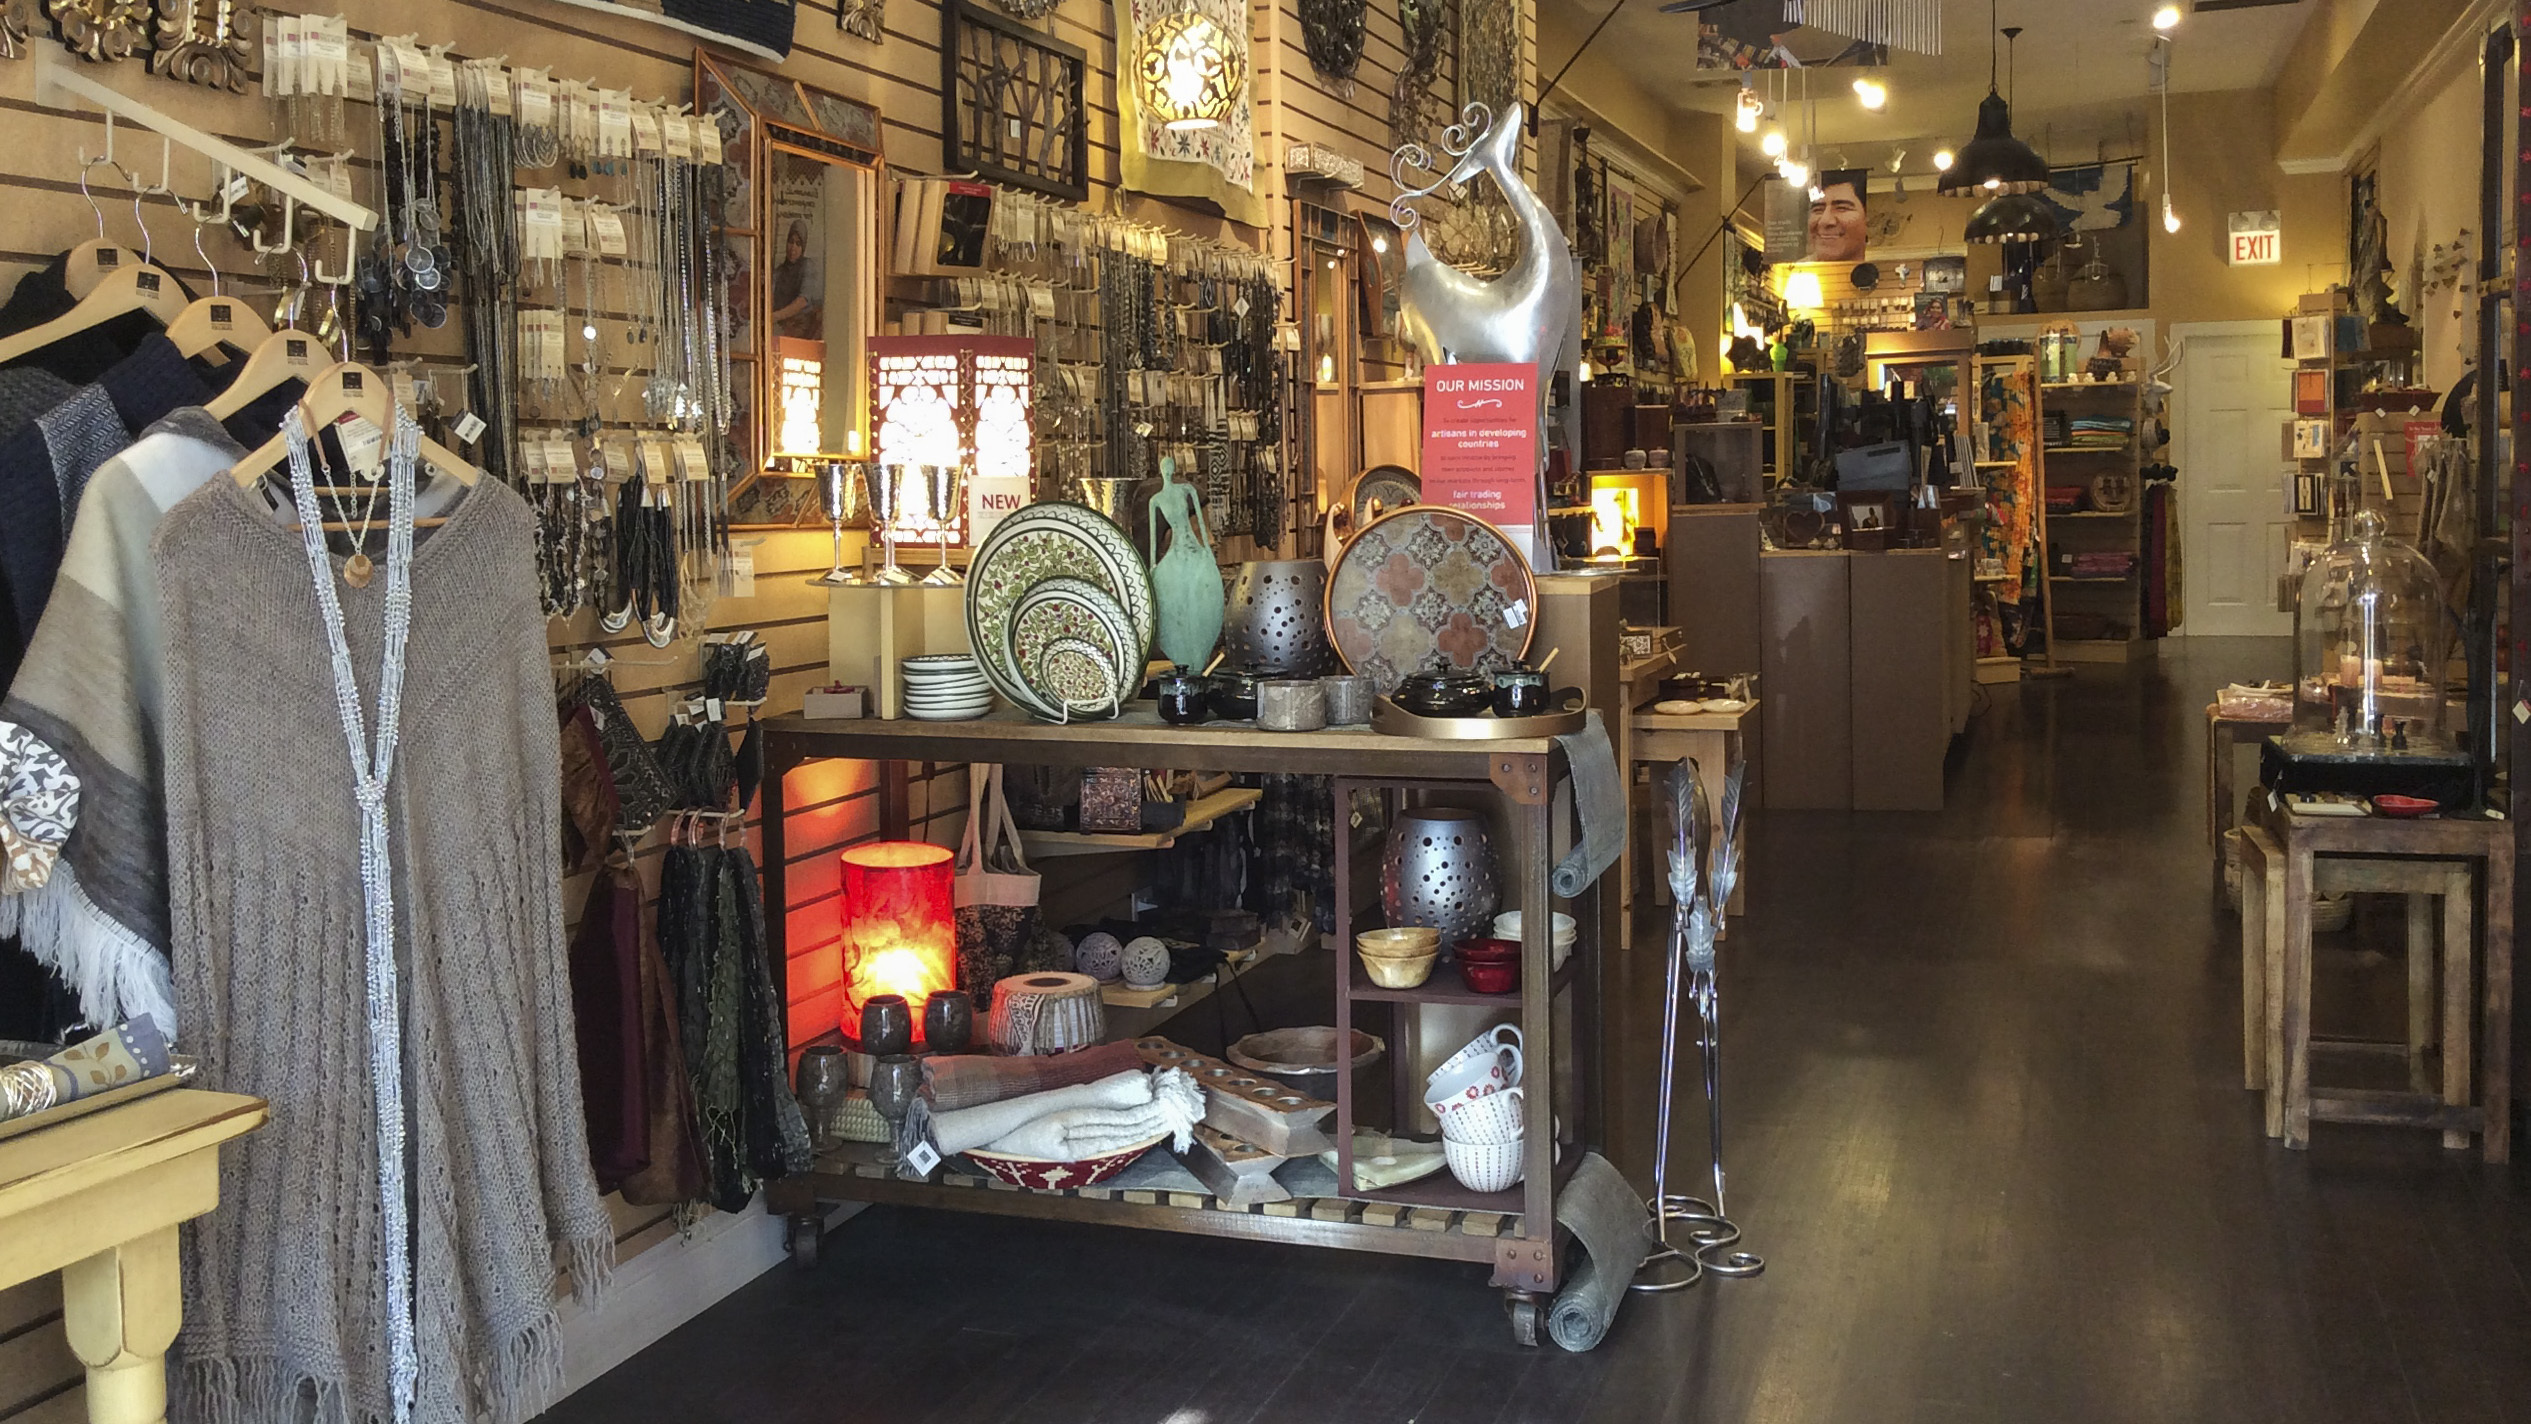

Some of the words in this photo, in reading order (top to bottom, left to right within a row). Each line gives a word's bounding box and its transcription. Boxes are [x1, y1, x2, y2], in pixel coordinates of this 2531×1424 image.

[2236, 235, 2274, 260] EXIT
[1436, 380, 1465, 392] OUR
[1468, 379, 1525, 392] MISSION
[1431, 430, 1467, 438] artisans
[1468, 429, 1478, 437] in
[1479, 428, 1527, 438] developing
[1457, 440, 1500, 448] countries
[1453, 490, 1468, 499] fair
[1469, 489, 1502, 500] trading
[982, 494, 1021, 510] NEW
